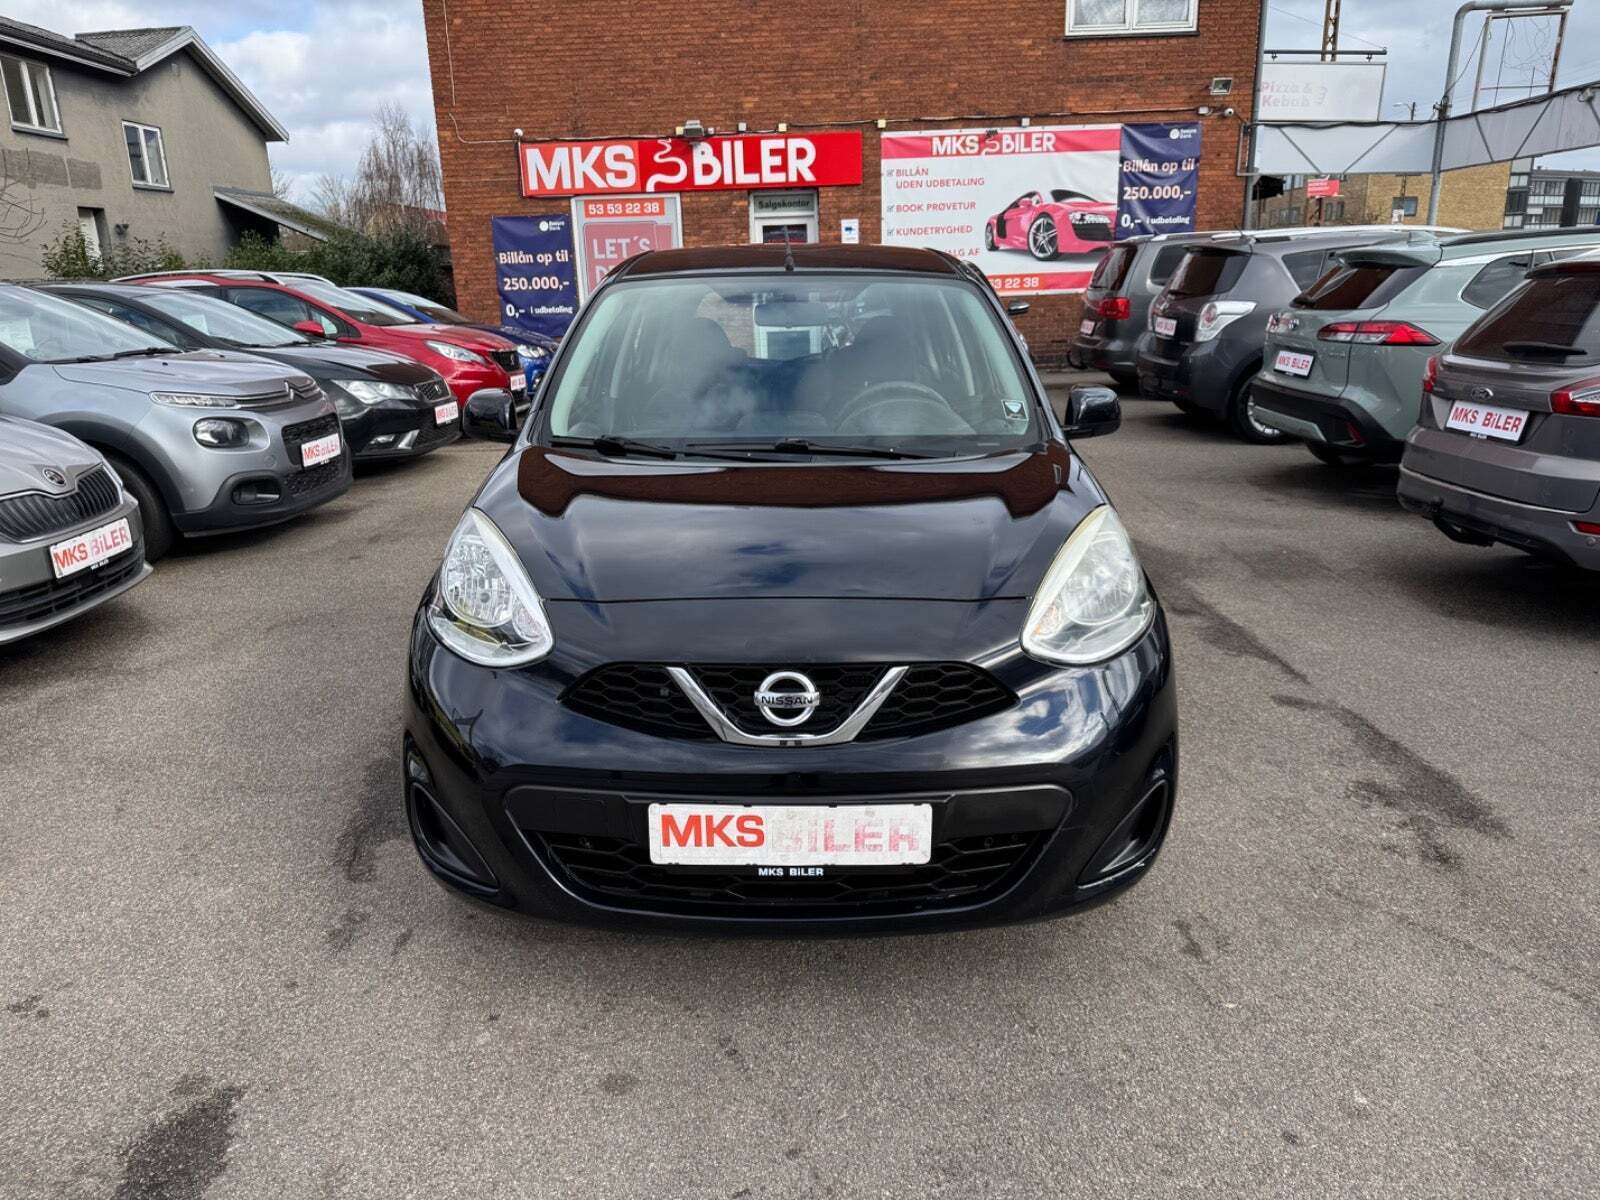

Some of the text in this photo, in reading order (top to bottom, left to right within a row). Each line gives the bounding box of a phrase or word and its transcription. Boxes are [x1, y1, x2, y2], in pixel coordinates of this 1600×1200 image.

[931, 132, 1056, 155] MKS BILER
[526, 138, 816, 191] MKS BILER
[1123, 158, 1195, 175] Billån op til
[896, 177, 985, 189] UDEN UDBETALING
[1123, 185, 1191, 200] 250.000,-
[588, 202, 659, 215] 53 53 22 38
[896, 203, 925, 213] BOOK
[896, 225, 973, 236] KUNDETRYGHED
[499, 249, 569, 266] Billån op til
[503, 277, 570, 291] 250.000,-
[1004, 278, 1021, 288] 22
[506, 304, 525, 318] 0,-
[1451, 407, 1479, 424] MKS
[53, 542, 88, 569] MKS
[761, 695, 813, 706] NISSAN
[661, 814, 765, 848] MKS
[758, 867, 784, 877] MKS
